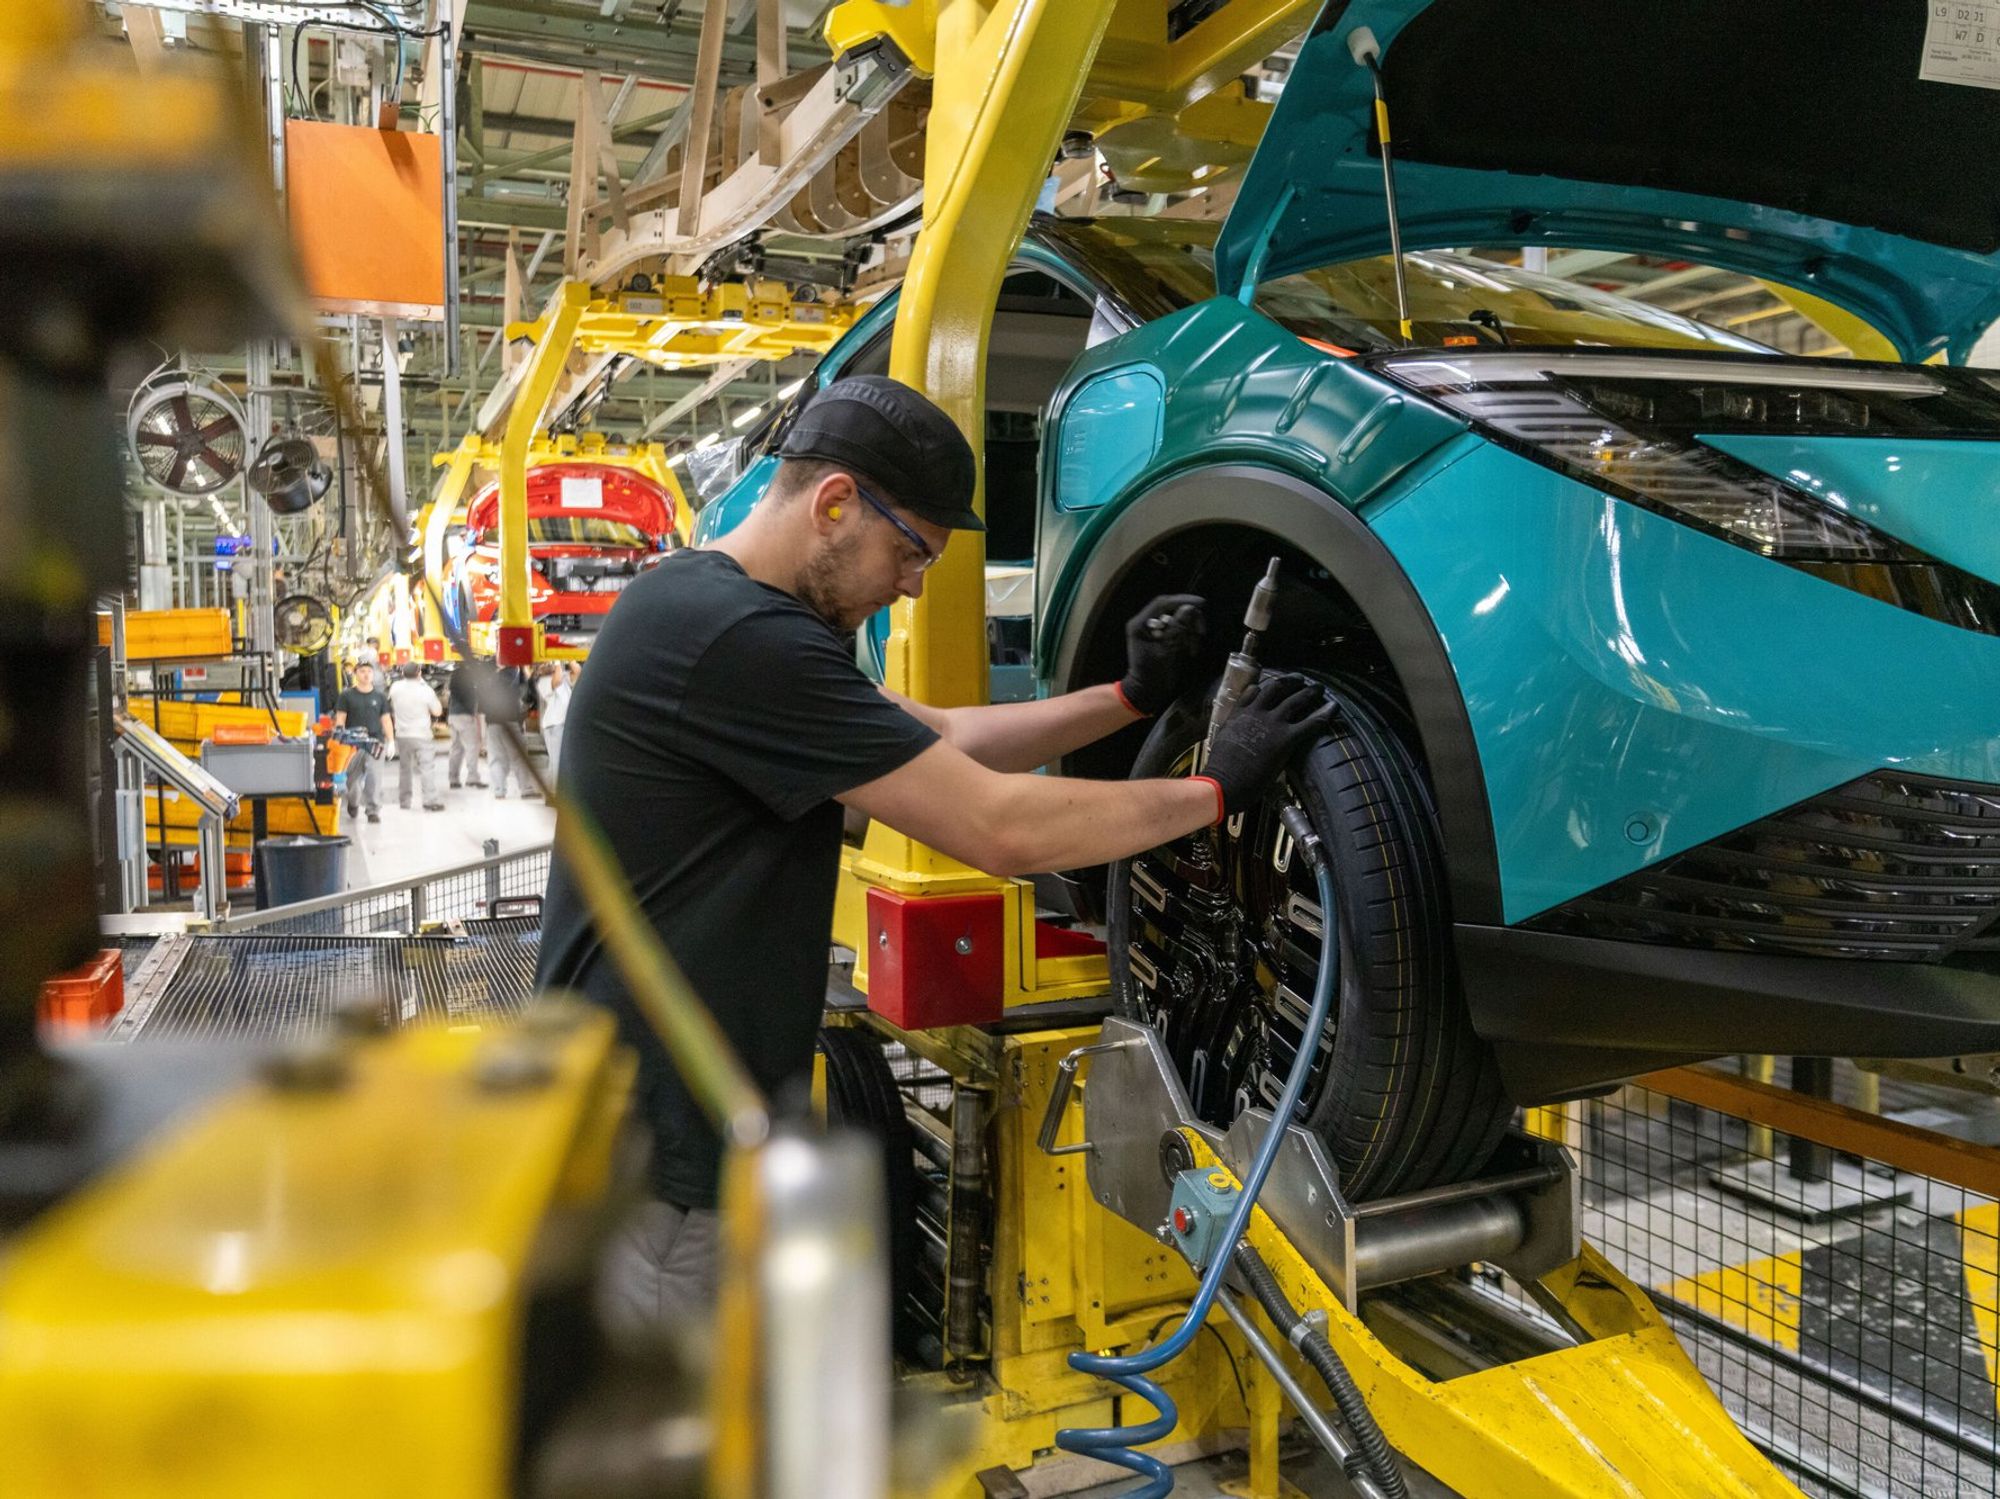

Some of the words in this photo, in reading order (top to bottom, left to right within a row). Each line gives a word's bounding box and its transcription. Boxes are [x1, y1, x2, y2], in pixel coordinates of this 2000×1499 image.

[1935, 7, 1947, 17] L9
[1958, 9, 1970, 20] D2
[1955, 30, 1968, 41] W7
[1976, 32, 1984, 43] D
